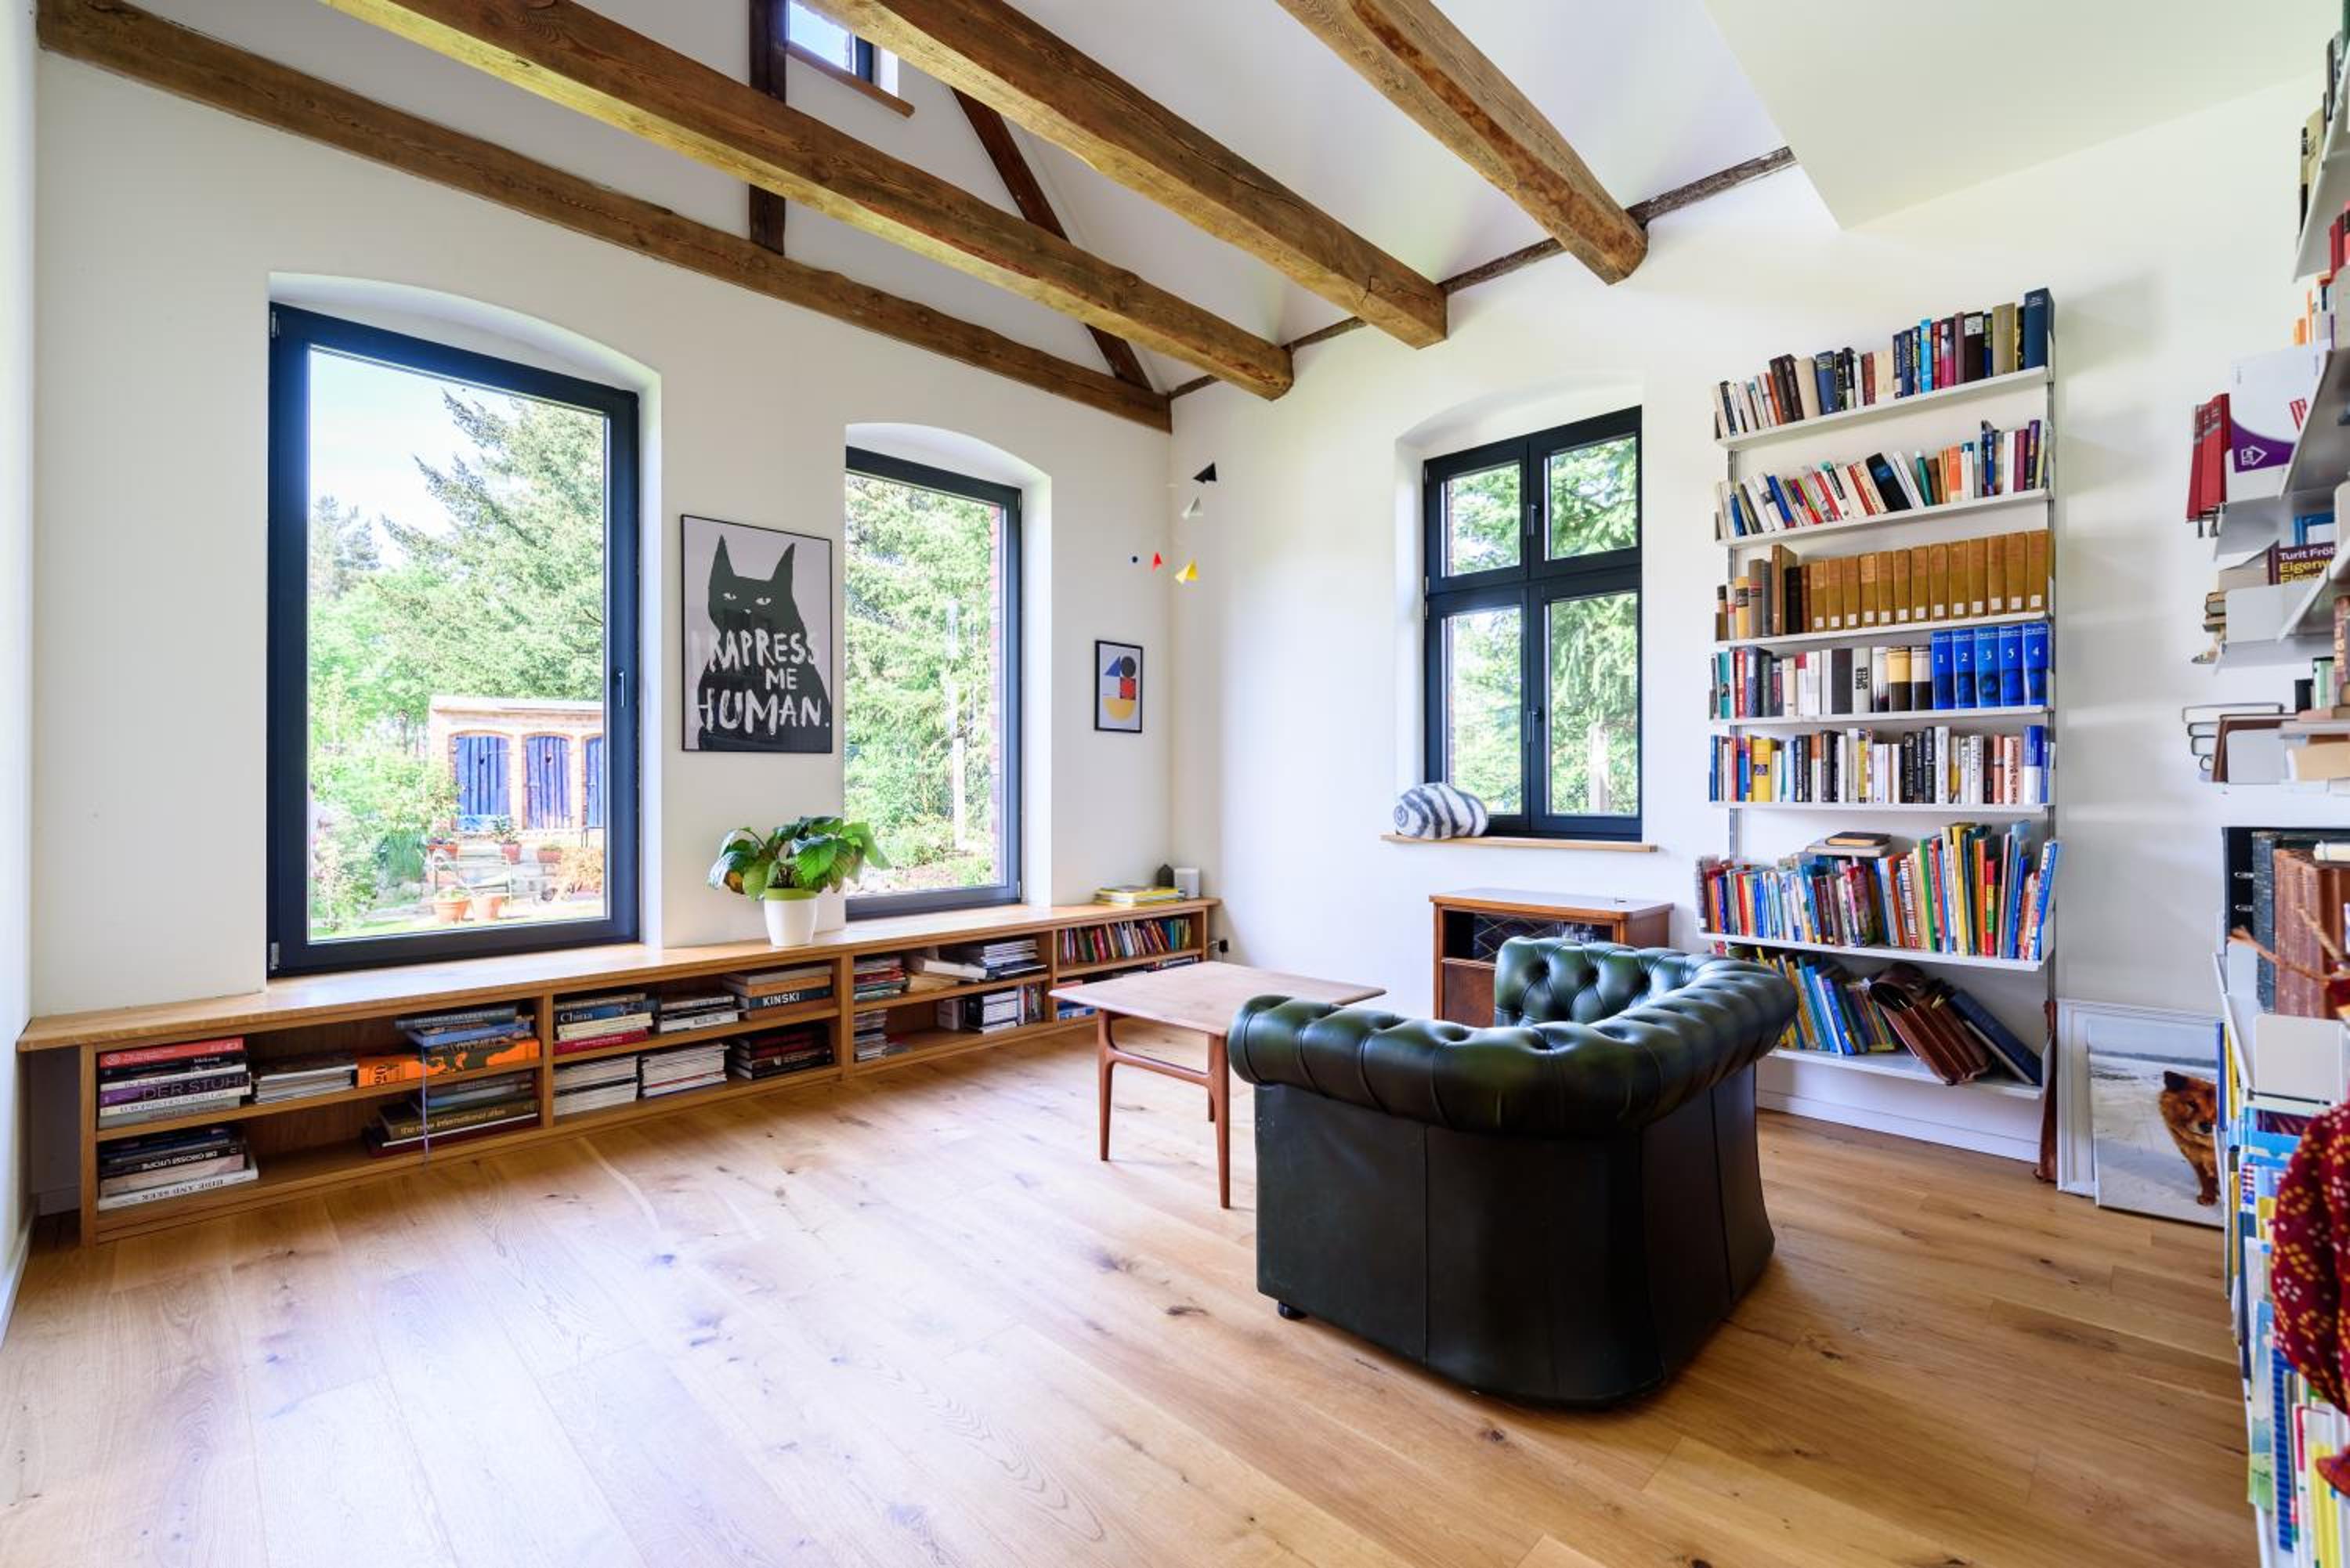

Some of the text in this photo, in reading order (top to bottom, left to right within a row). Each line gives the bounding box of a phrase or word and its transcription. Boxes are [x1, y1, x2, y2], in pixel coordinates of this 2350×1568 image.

[2280, 550, 2308, 561] Turit
[690, 629, 820, 672] IMPRESS
[1984, 651, 1992, 660] 3
[2008, 648, 2015, 658] 5
[2033, 647, 2040, 656] 4
[1937, 654, 1944, 664] 1
[1961, 652, 1969, 662] 2
[765, 667, 798, 691] ME
[689, 688, 830, 735] HUMAN.
[762, 992, 800, 1006] KINSKI
[559, 1011, 593, 1023] China
[143, 1082, 184, 1100] DER
[189, 1075, 249, 1094] STUHL
[173, 1183, 194, 1194] AND
